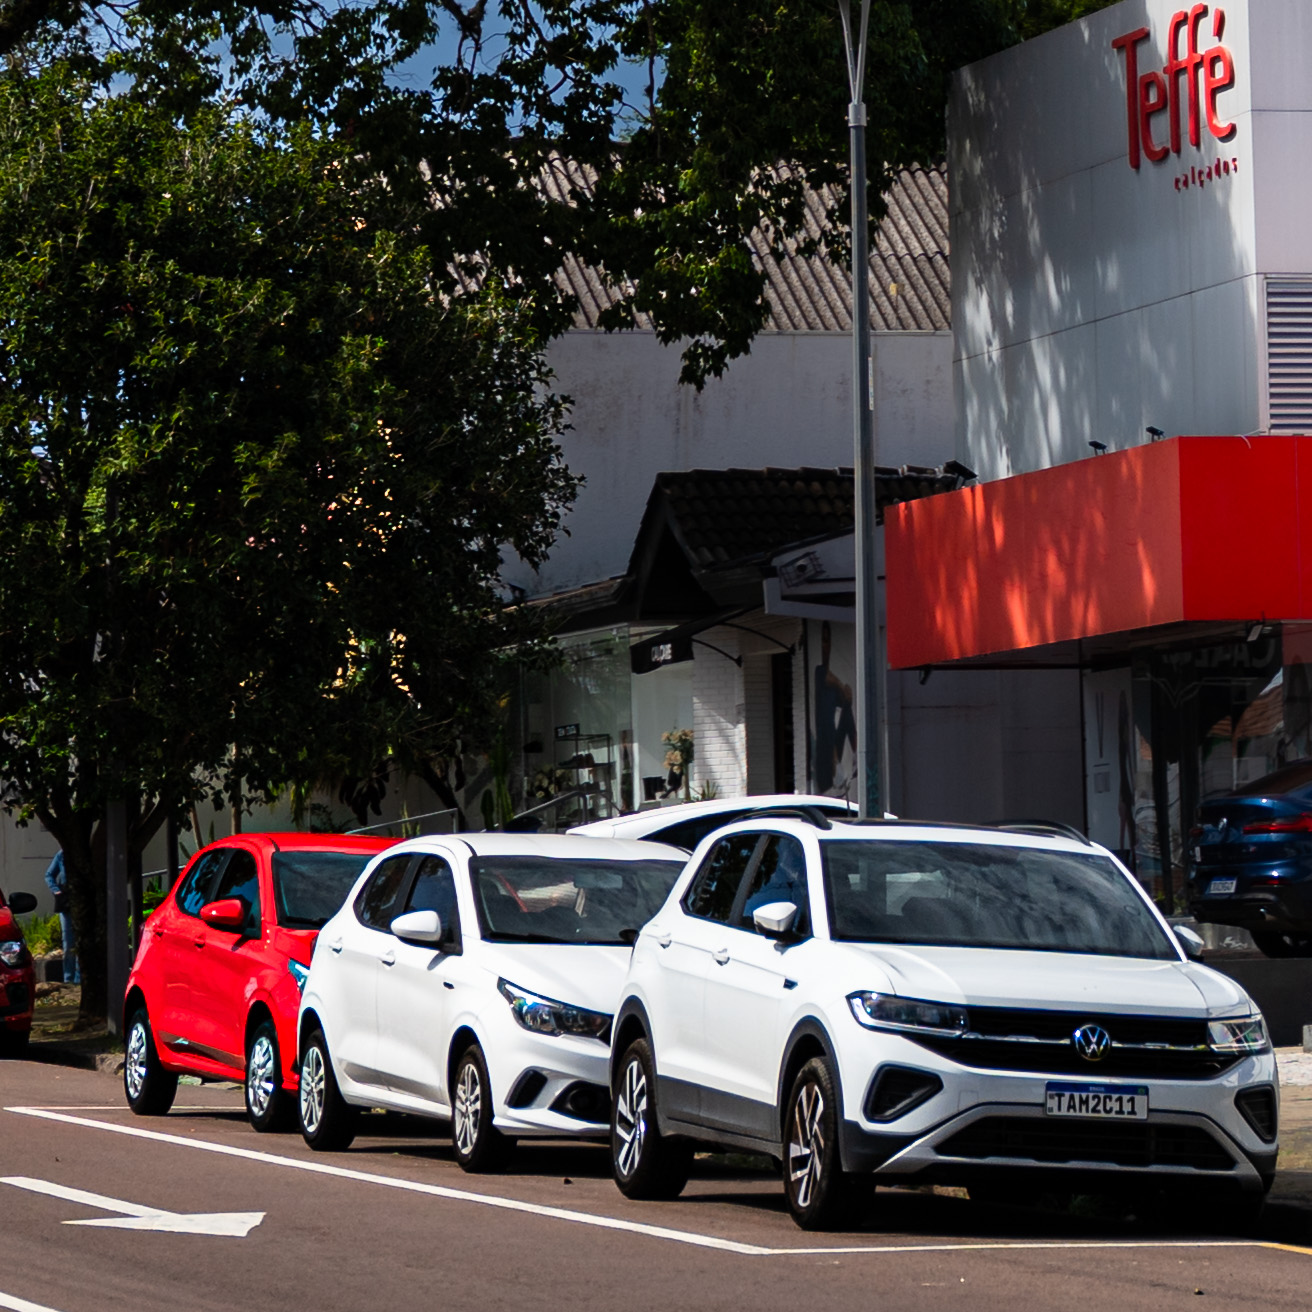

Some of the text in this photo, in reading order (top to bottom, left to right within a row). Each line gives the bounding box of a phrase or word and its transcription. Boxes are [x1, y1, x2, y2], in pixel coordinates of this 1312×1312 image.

[1111, 3, 1237, 170] Teffé
[1174, 157, 1238, 192] calçados
[1054, 1092, 1137, 1116] TAM2C11
